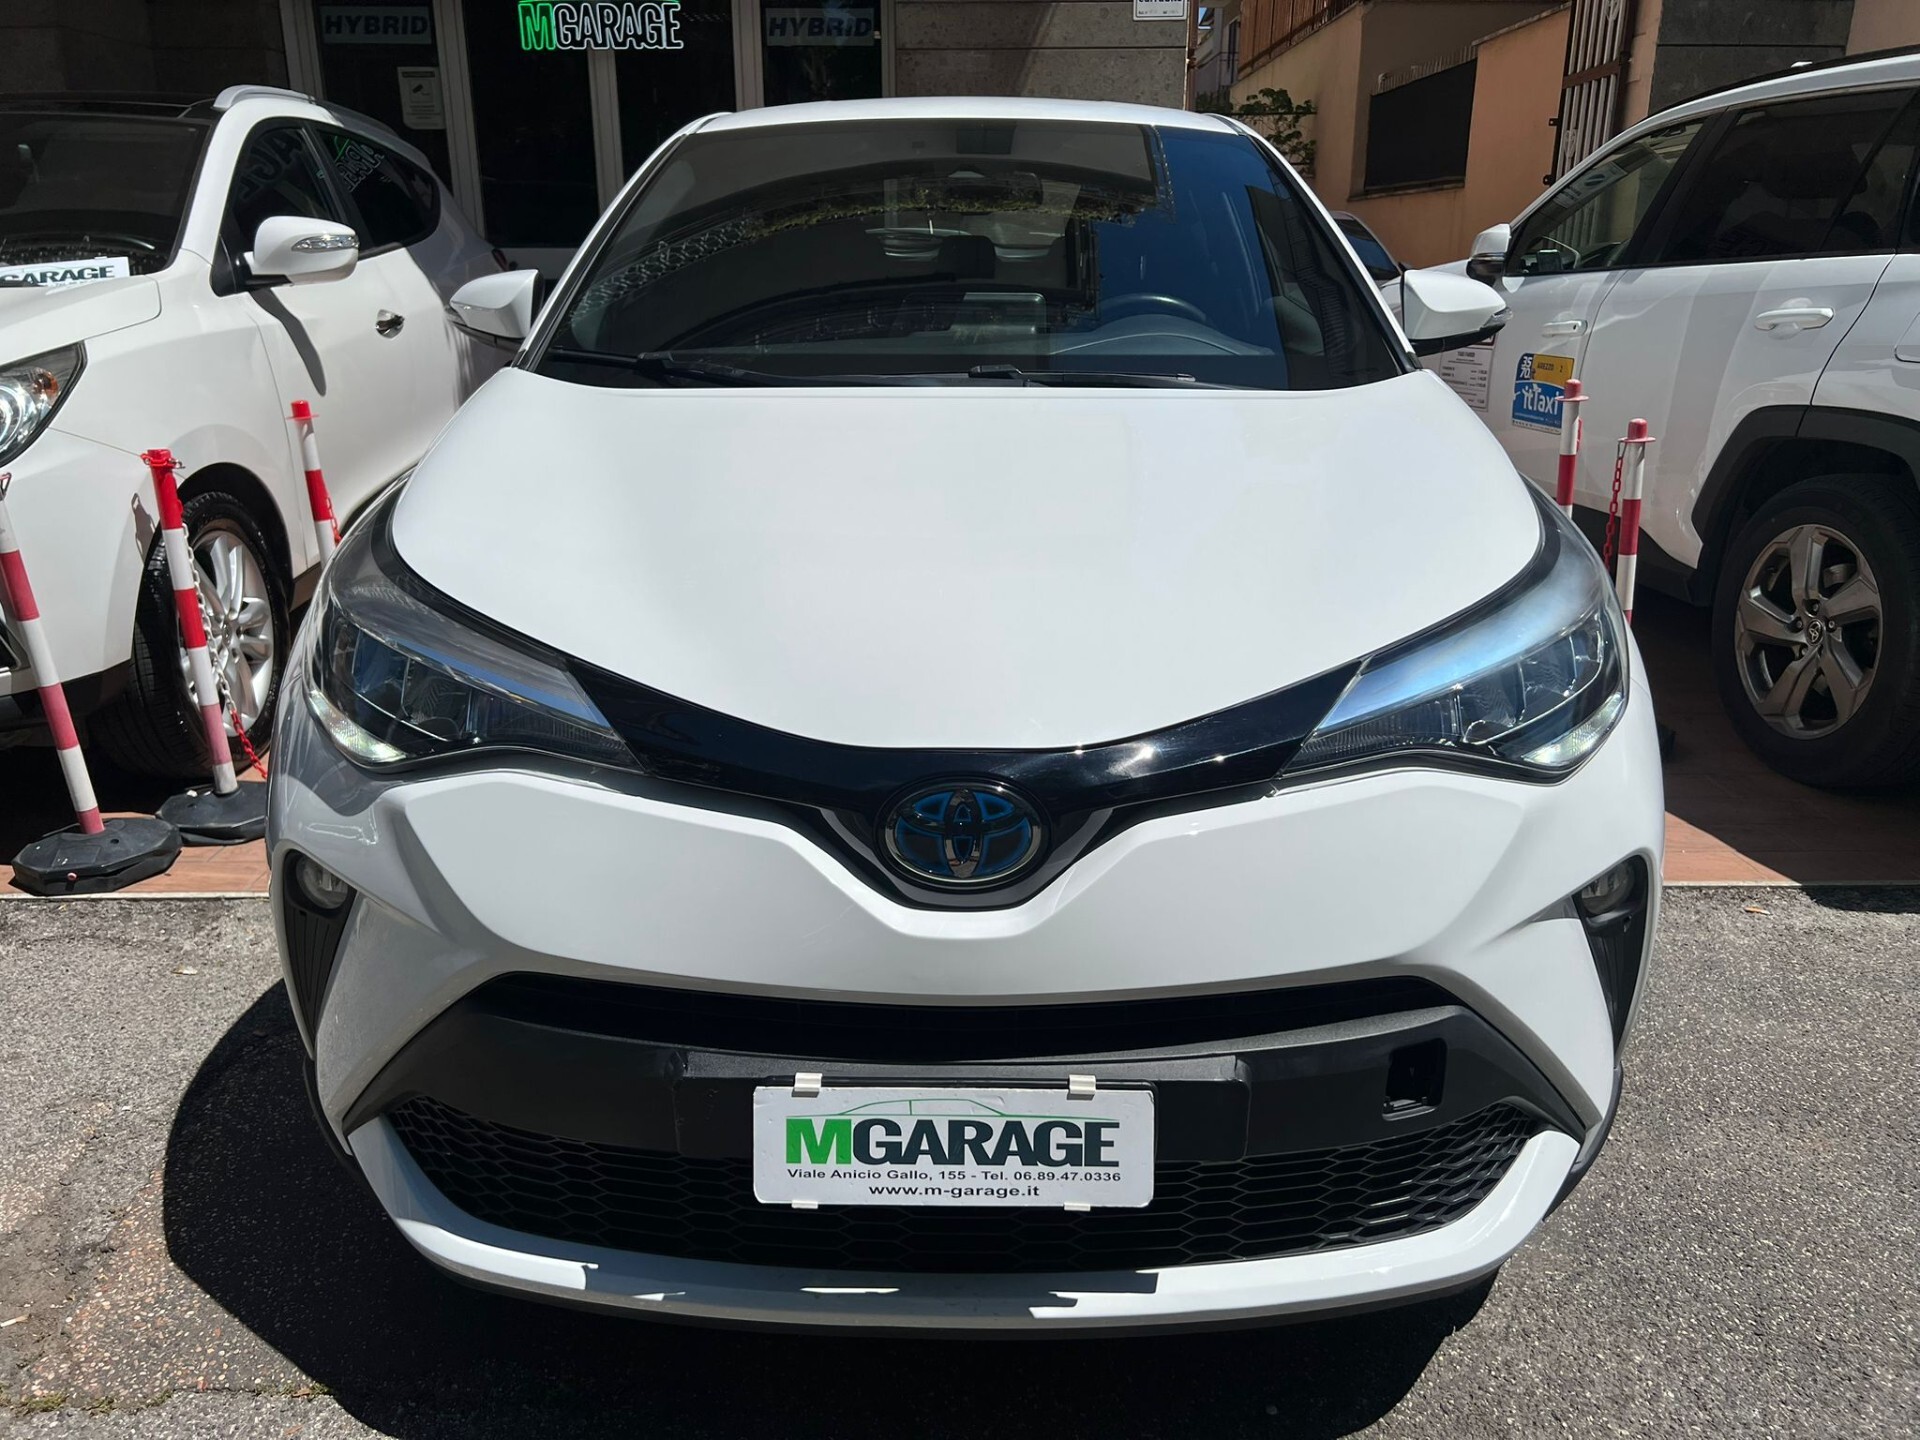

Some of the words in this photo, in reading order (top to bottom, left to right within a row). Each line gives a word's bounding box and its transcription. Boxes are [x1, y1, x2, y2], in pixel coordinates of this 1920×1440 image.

[324, 14, 429, 35] HYBRID
[518, 2, 684, 50] MGARAGE
[768, 17, 873, 37] HYBRID
[785, 1118, 1120, 1168] MGARAGE
[787, 1169, 826, 1179] Viale
[830, 1169, 882, 1180] Anicio
[886, 1170, 933, 1181] Gallo,
[938, 1171, 966, 1180] 155
[981, 1171, 1008, 1181] Tel.
[1013, 1171, 1121, 1182] 06.89.47.0336
[868, 1185, 1040, 1198] www.m-garage.it
